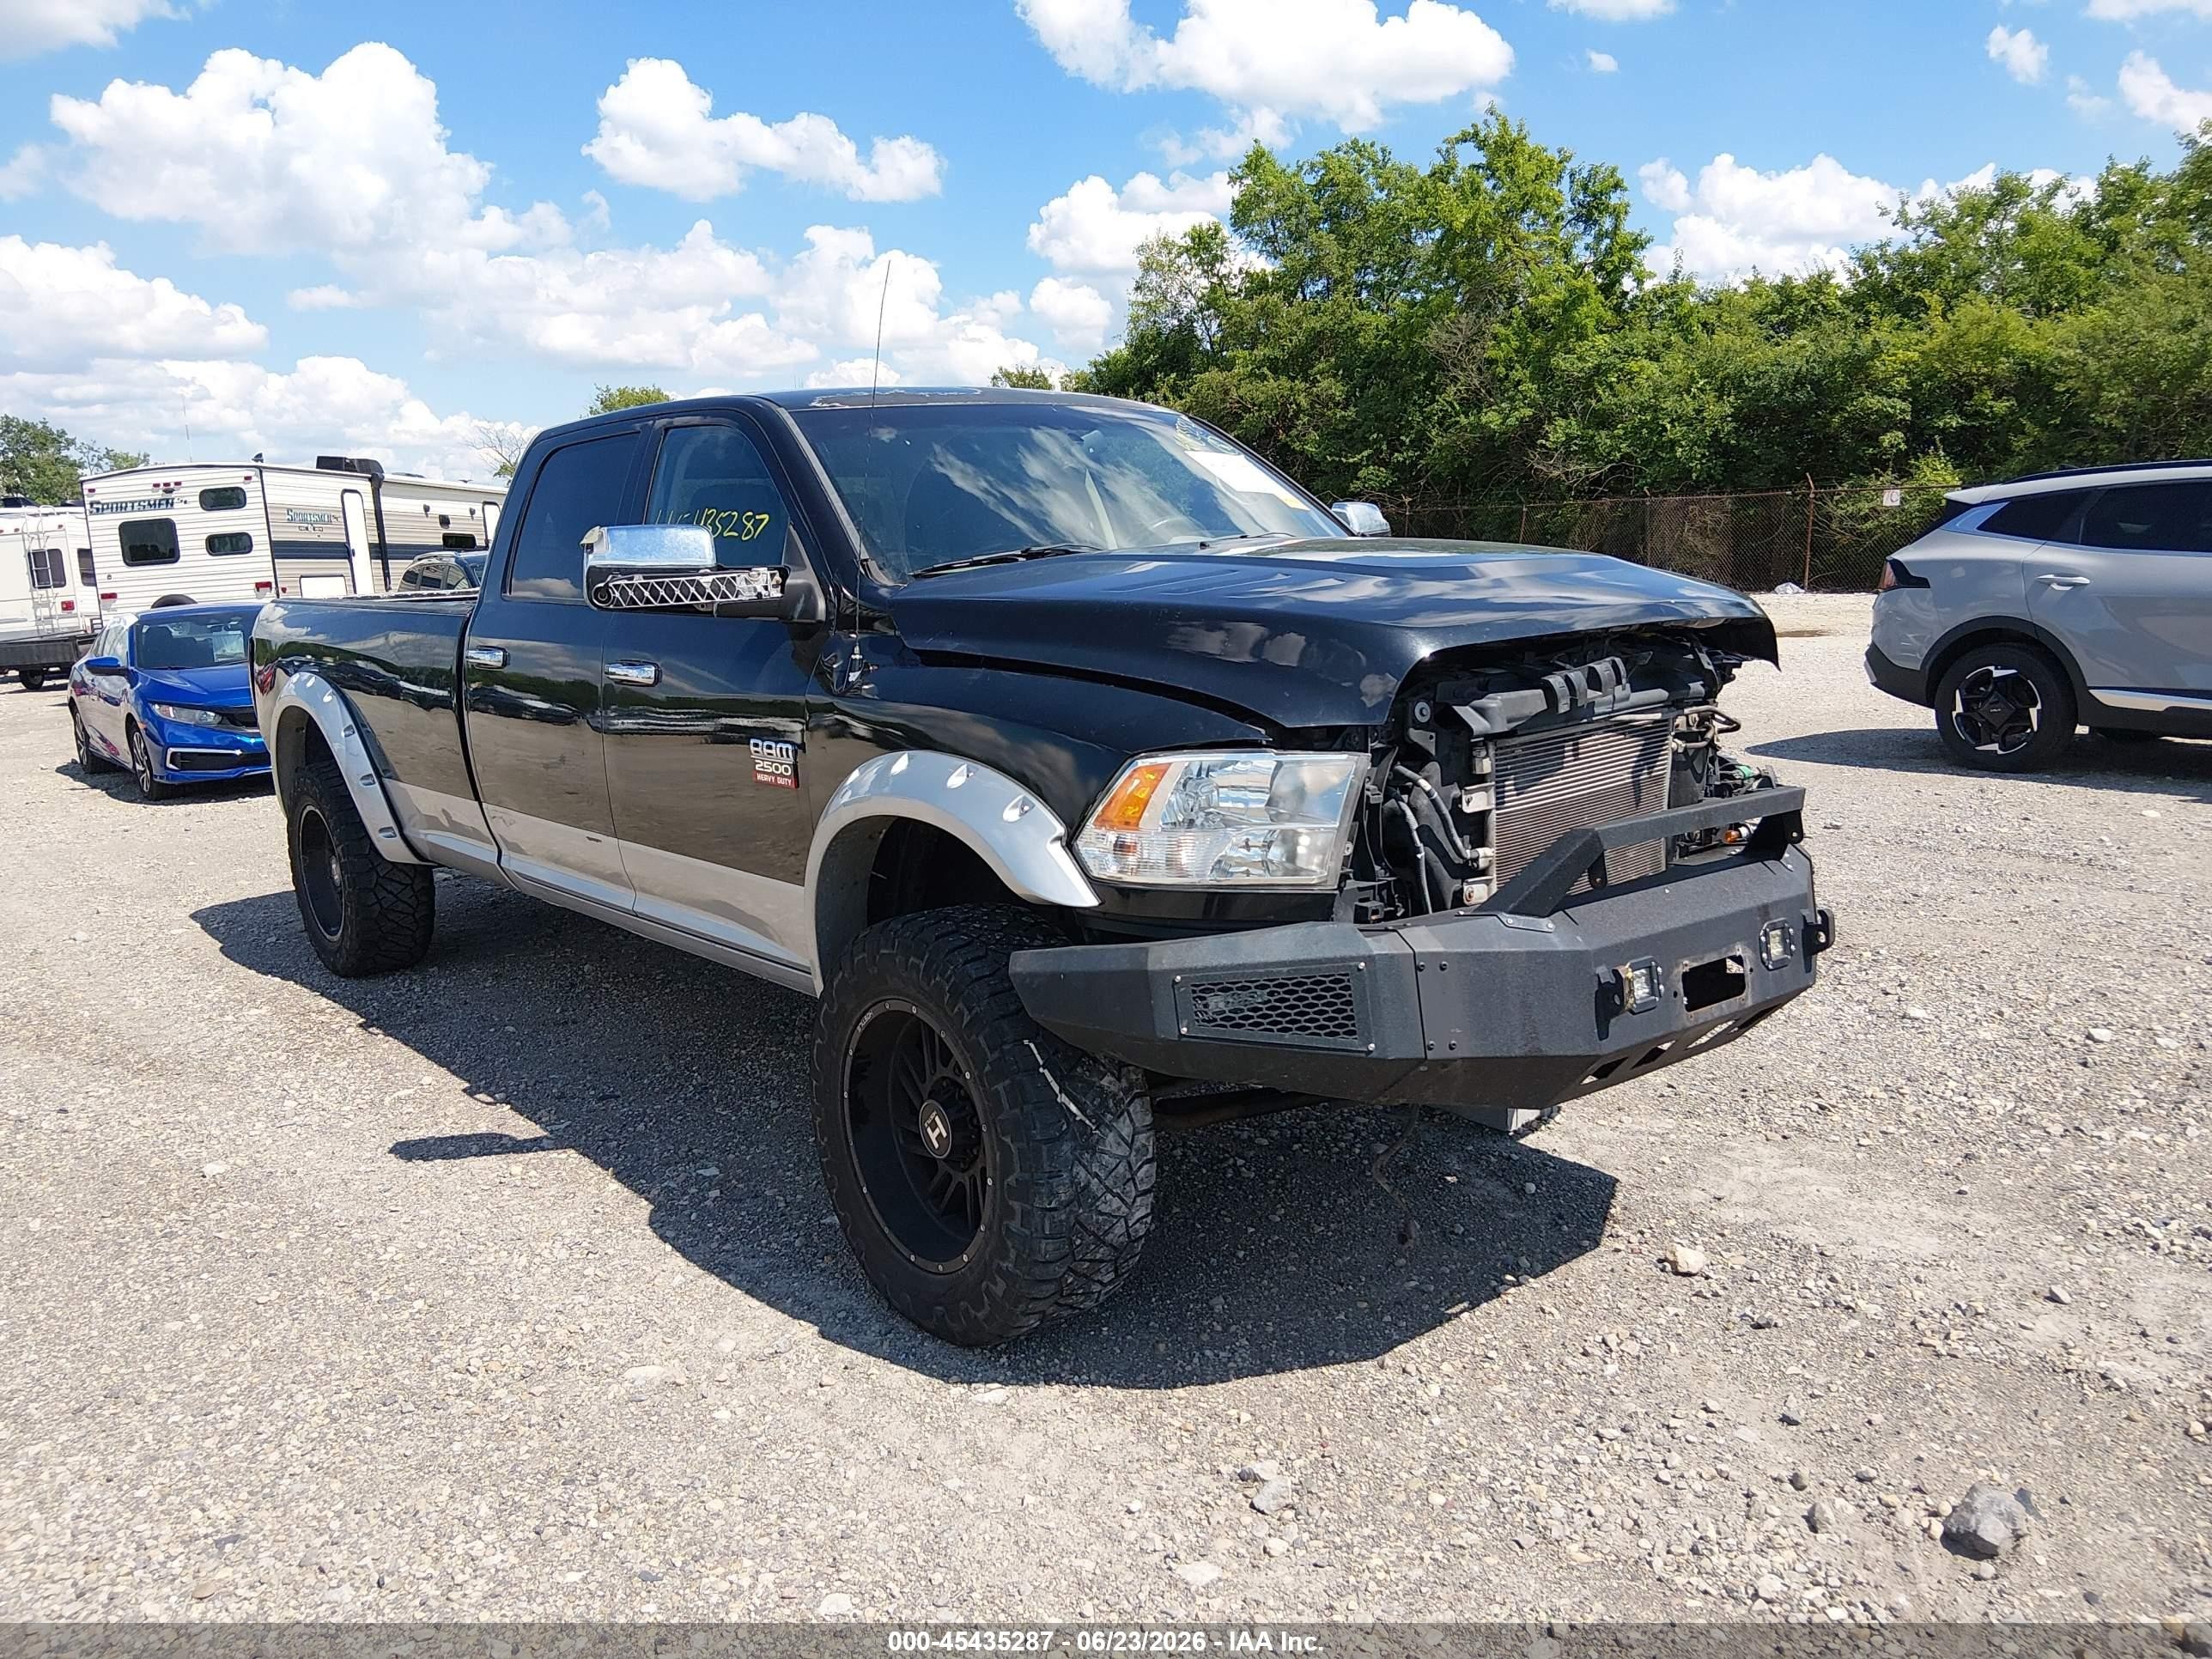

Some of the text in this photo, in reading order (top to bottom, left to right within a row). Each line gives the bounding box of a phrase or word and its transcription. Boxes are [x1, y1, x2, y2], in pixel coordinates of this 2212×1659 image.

[88, 498, 175, 515] SPORTSMEN
[286, 508, 332, 523] SPORTSMEN
[750, 738, 794, 762] RAM
[755, 759, 792, 775] 2500
[757, 773, 792, 786] HEAVY DUTY
